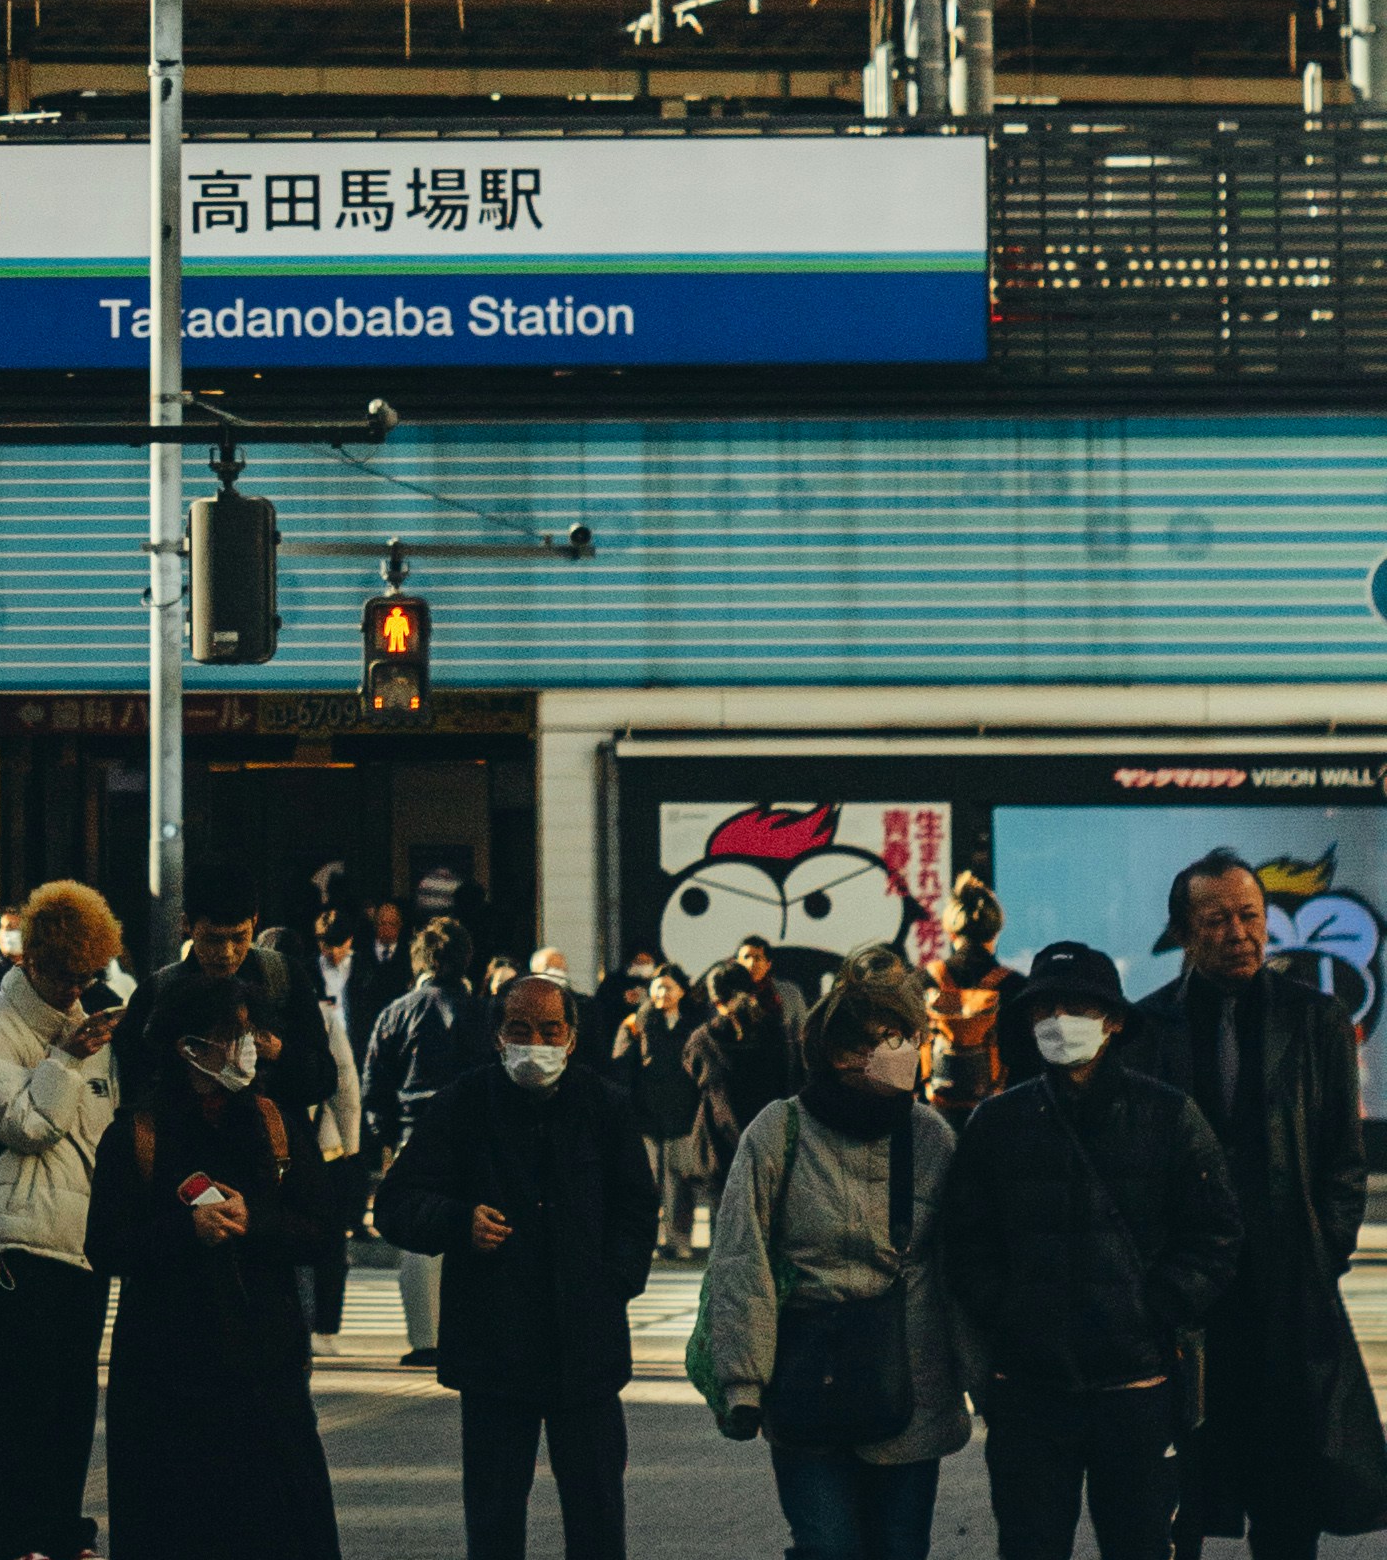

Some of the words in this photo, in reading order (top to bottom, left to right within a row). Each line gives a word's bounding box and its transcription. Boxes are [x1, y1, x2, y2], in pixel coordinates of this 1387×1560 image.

[188, 167, 544, 234] 高田馬場駅
[468, 295, 634, 337] Station
[1251, 768, 1317, 788] VISION
[1321, 768, 1376, 787] WALL
